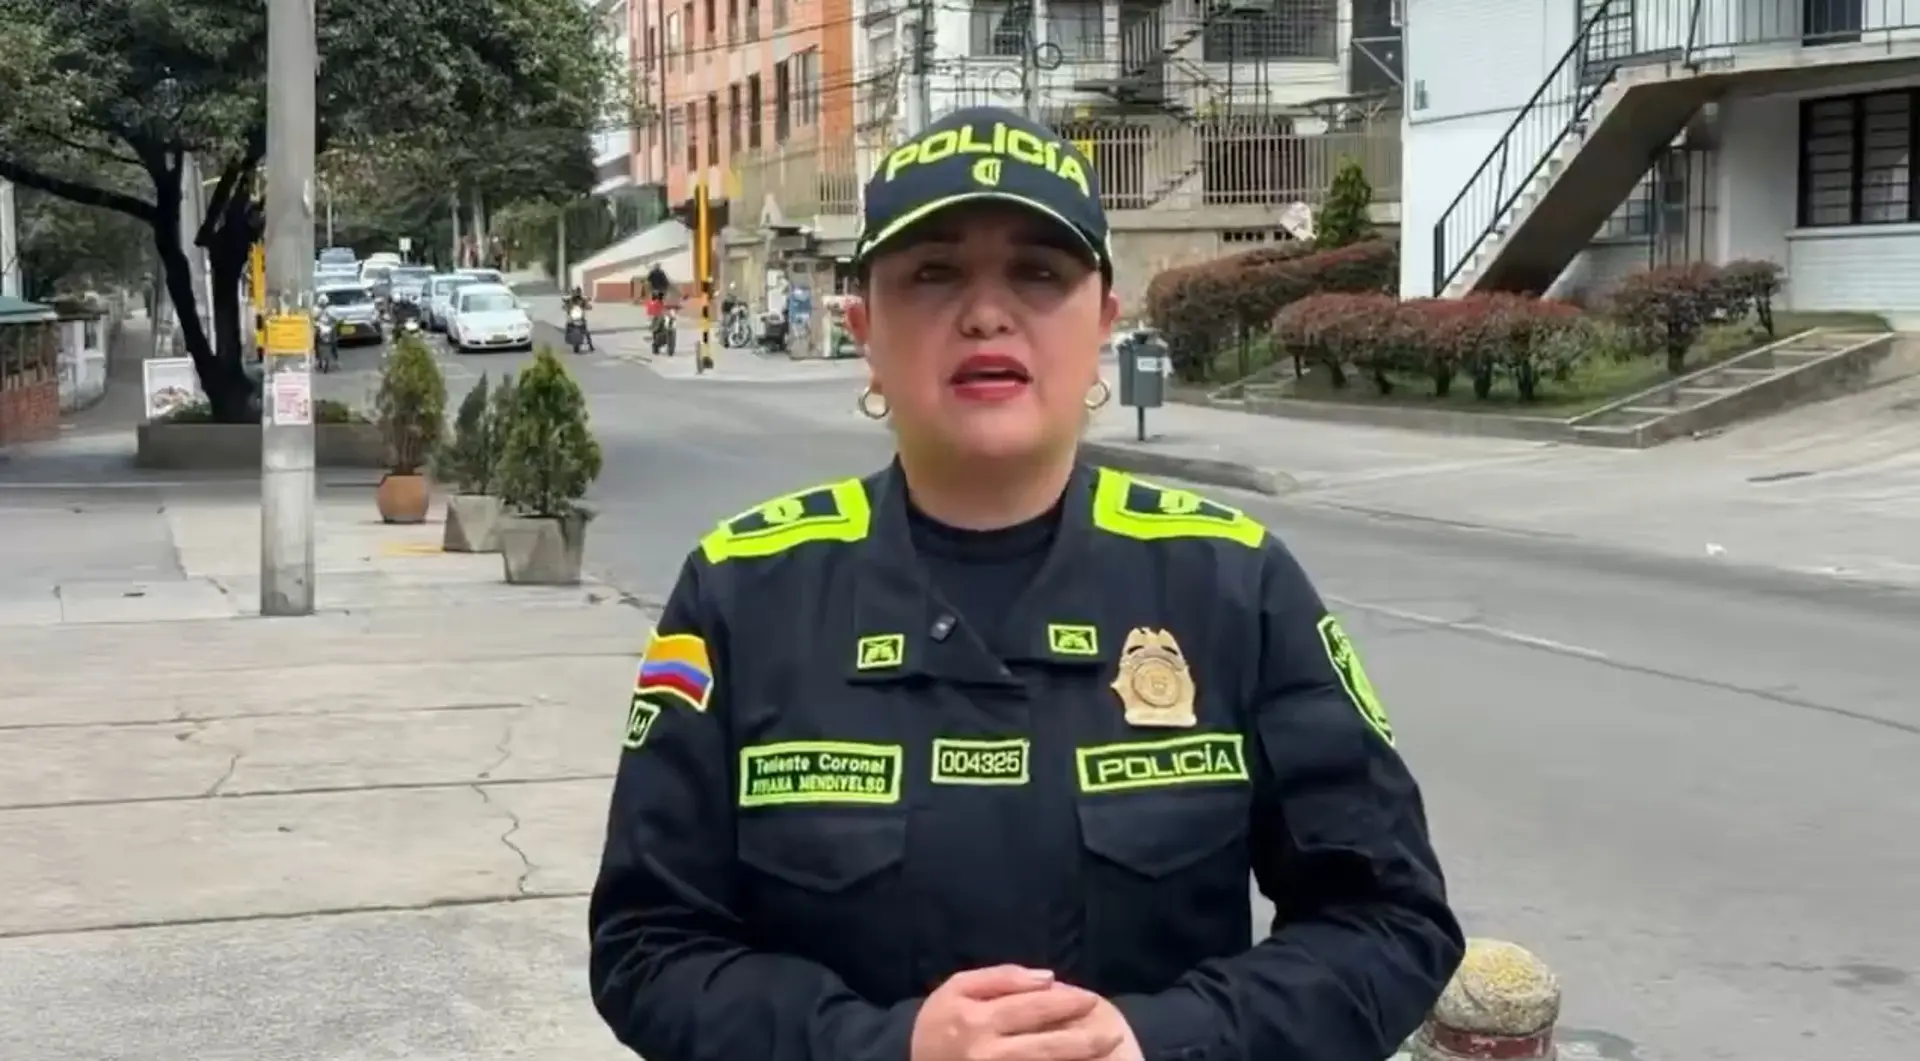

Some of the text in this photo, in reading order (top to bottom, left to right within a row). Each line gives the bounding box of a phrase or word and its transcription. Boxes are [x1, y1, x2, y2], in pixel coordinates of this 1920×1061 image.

[885, 121, 1091, 198] POLICÍA
[941, 749, 1021, 774] 004325
[1096, 742, 1235, 783] POLICÍA
